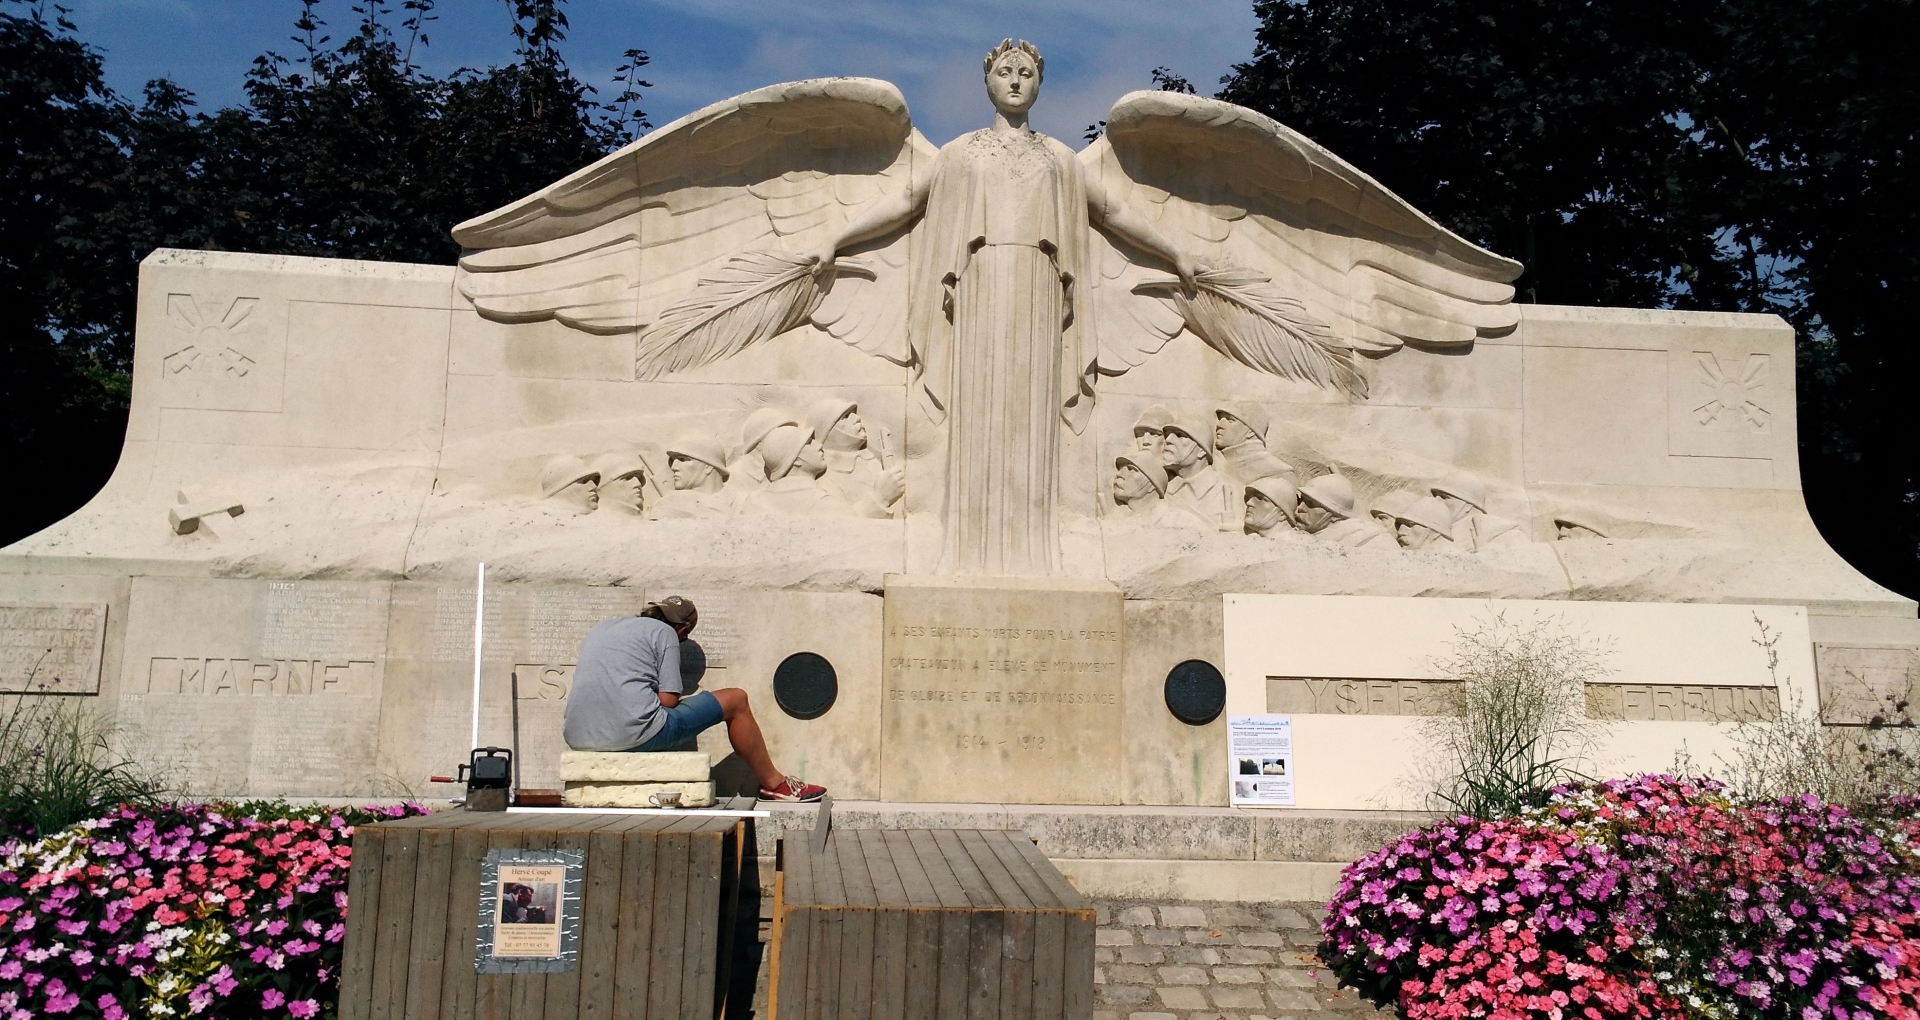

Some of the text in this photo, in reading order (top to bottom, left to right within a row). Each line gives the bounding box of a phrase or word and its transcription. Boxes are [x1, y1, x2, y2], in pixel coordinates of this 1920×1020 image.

[903, 626, 926, 638] SES
[1025, 629, 1056, 641] POUR
[1059, 630, 1075, 642] LA
[1079, 630, 1118, 642] PATRIE
[1052, 661, 1117, 674] MONUMENT
[179, 658, 348, 696] MARNE
[889, 689, 906, 702] DE
[960, 691, 978, 703] ET
[985, 691, 1002, 703] DE
[1302, 679, 1428, 716] YSER
[1588, 684, 1778, 722] VERDUN
[532, 868, 552, 876] Coupé
